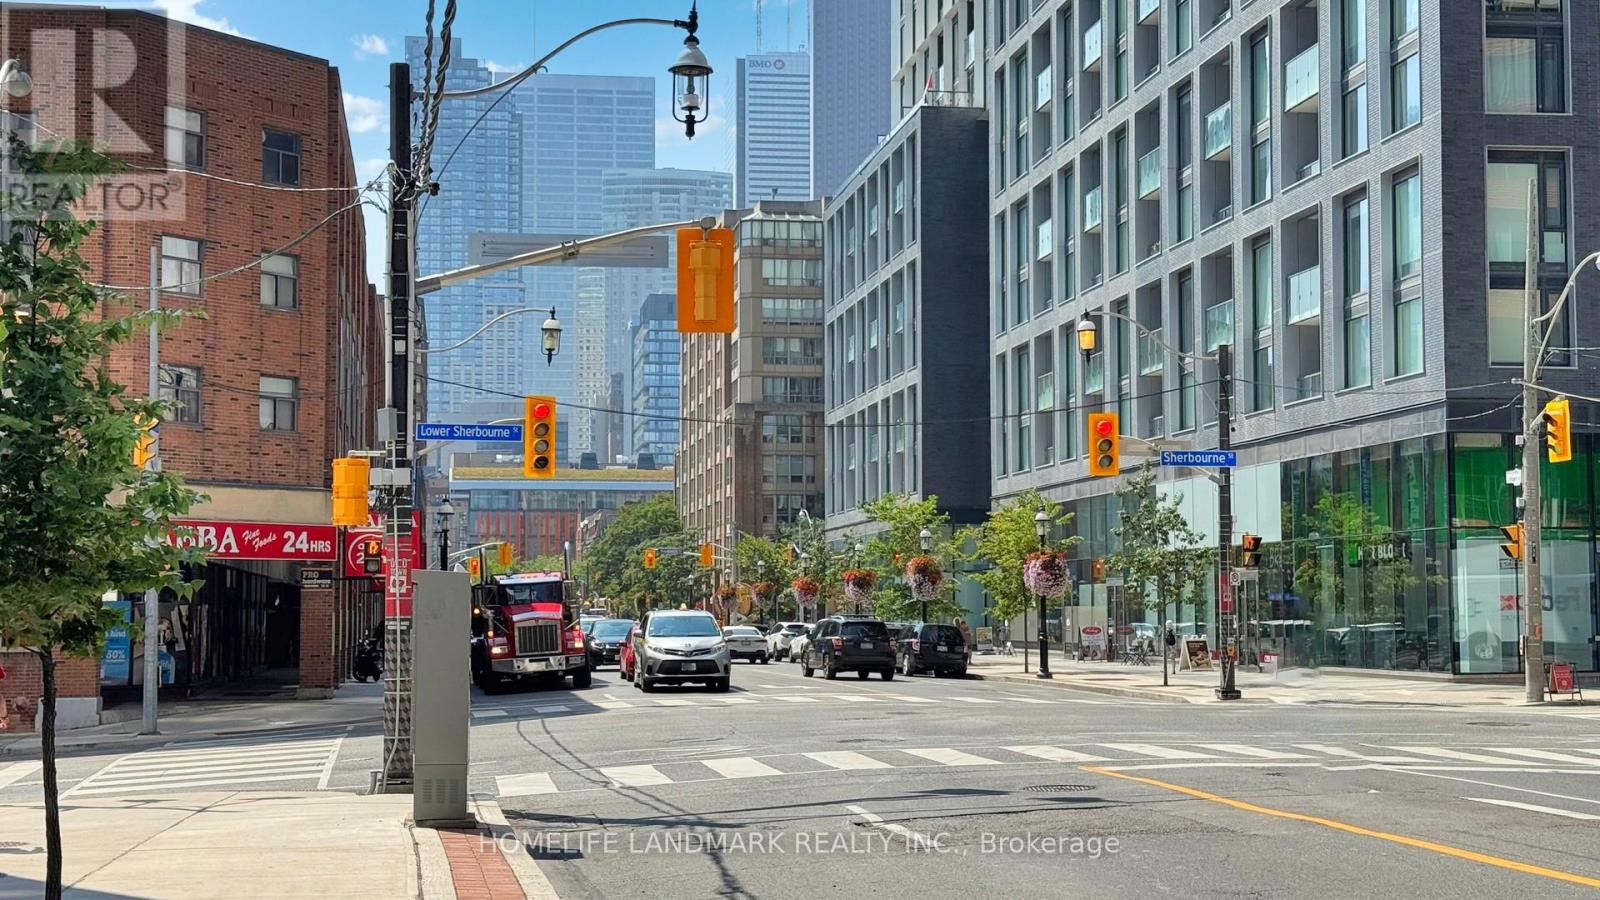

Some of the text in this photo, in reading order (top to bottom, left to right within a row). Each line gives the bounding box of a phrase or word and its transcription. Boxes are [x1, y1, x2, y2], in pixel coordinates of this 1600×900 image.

[749, 59, 772, 68] BMO
[420, 425, 451, 437] Lower
[453, 425, 511, 438] Sherbourne
[1163, 451, 1226, 464] Sherbourne
[242, 529, 260, 545] Fine
[252, 532, 277, 552] Foods
[282, 531, 331, 553] 24 HRS
[105, 649, 126, 660] 50%
